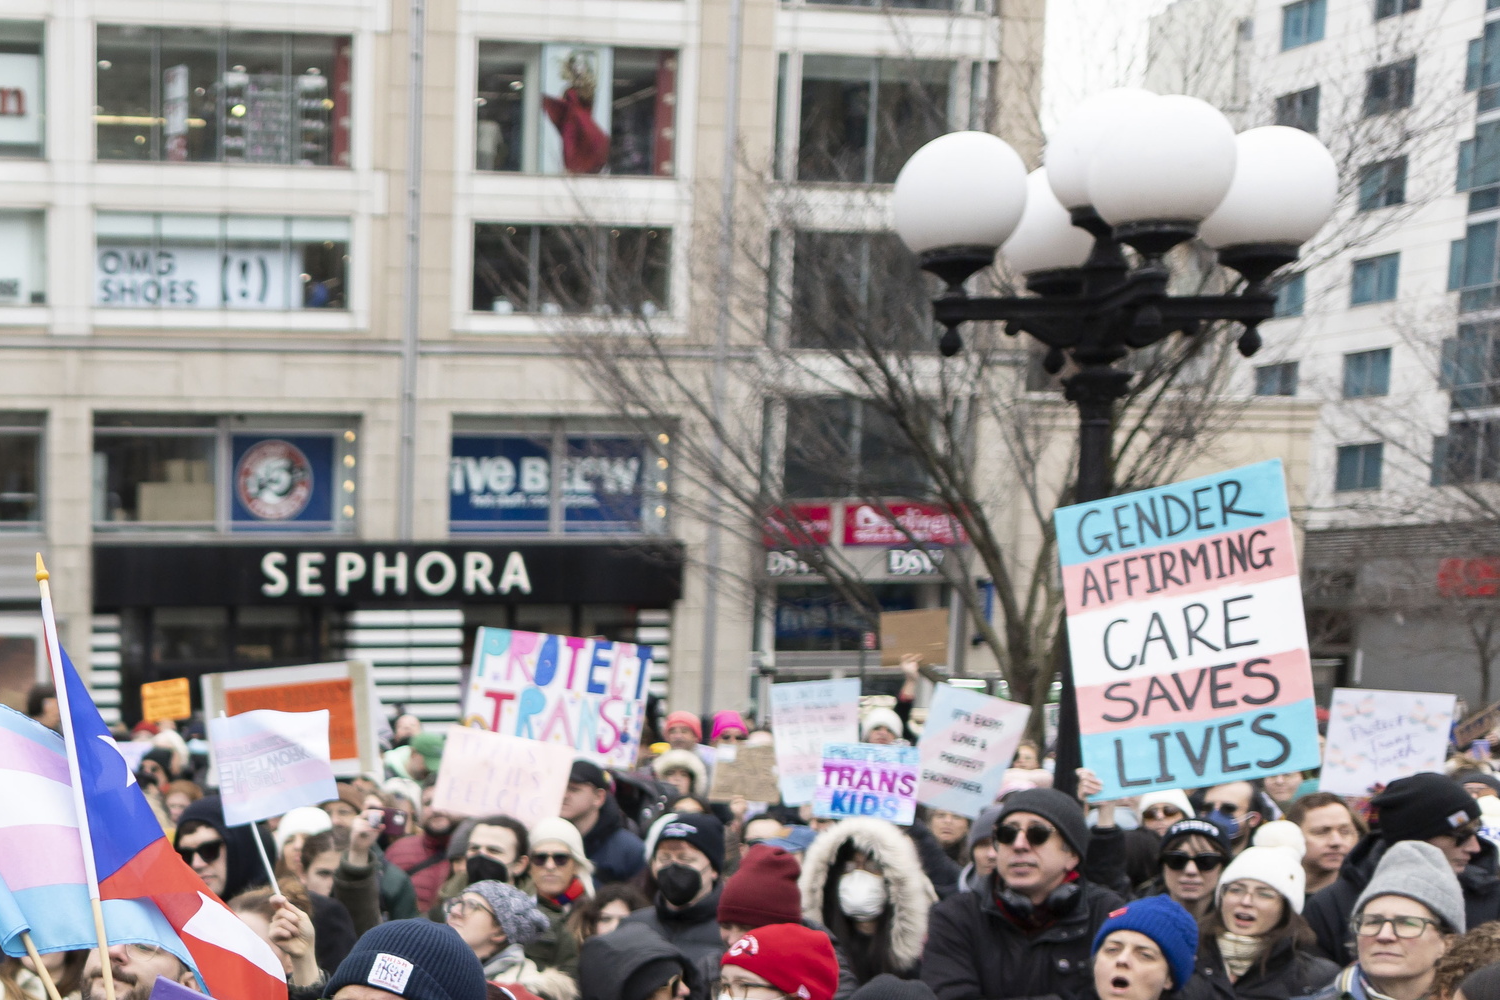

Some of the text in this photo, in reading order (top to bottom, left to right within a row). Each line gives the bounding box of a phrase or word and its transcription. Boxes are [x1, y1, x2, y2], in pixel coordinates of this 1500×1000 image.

[100, 278, 199, 304] SHOES
[101, 249, 177, 276] OMG
[1076, 480, 1264, 557] GENDER
[261, 550, 532, 597] SEPHORA
[1081, 530, 1275, 606] AFFIRMING
[477, 626, 654, 701] PROTECT
[1102, 594, 1259, 671] CARE
[1101, 658, 1281, 723] SAVES
[823, 764, 917, 798] TRANS
[1113, 713, 1291, 788] LIVES
[830, 789, 900, 819] KIDS
